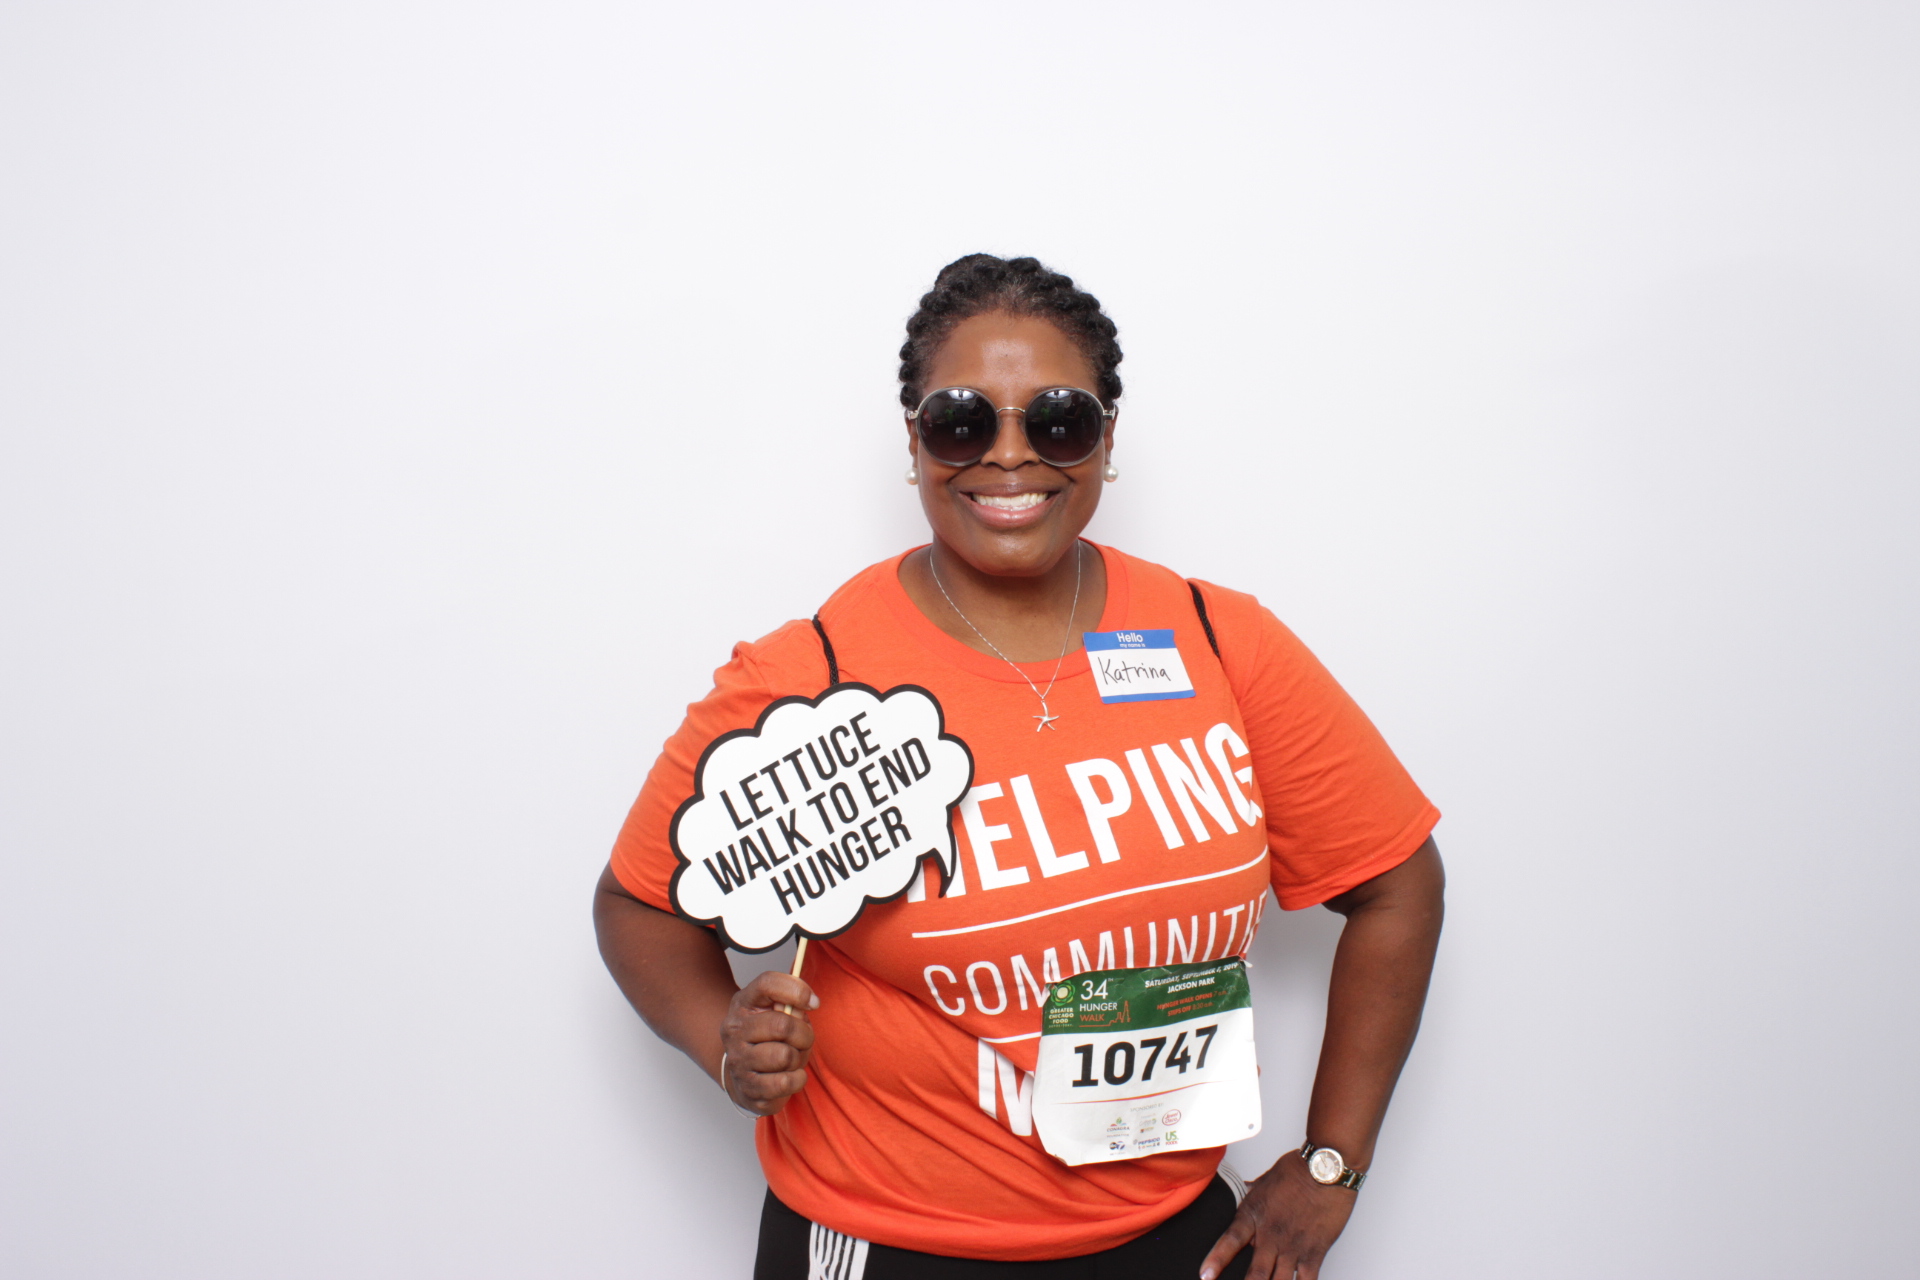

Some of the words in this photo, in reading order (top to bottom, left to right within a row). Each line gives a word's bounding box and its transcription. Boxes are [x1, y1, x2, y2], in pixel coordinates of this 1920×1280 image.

[1116, 632, 1144, 643] Hello
[1097, 656, 1172, 686] Katrina
[719, 711, 881, 831] LETTUCE
[702, 808, 812, 895] WALK
[806, 782, 859, 835] TO
[858, 737, 931, 808] END
[770, 806, 912, 916] HUNGER
[1144, 975, 1180, 988] SATURDAY,
[1181, 967, 1215, 981] SEPTEMBER
[1223, 961, 1238, 971] 2019
[1167, 980, 1197, 994] JACKSON
[1198, 977, 1215, 987] PARK
[1079, 1002, 1118, 1012] HUNGER
[1156, 998, 1179, 1010] HUNGER
[1179, 996, 1194, 1005] WALK
[1195, 992, 1213, 1001] OPENS
[1181, 1005, 1192, 1013] OFF
[1079, 1013, 1105, 1022] WALK
[1072, 1024, 1219, 1088] 10747
